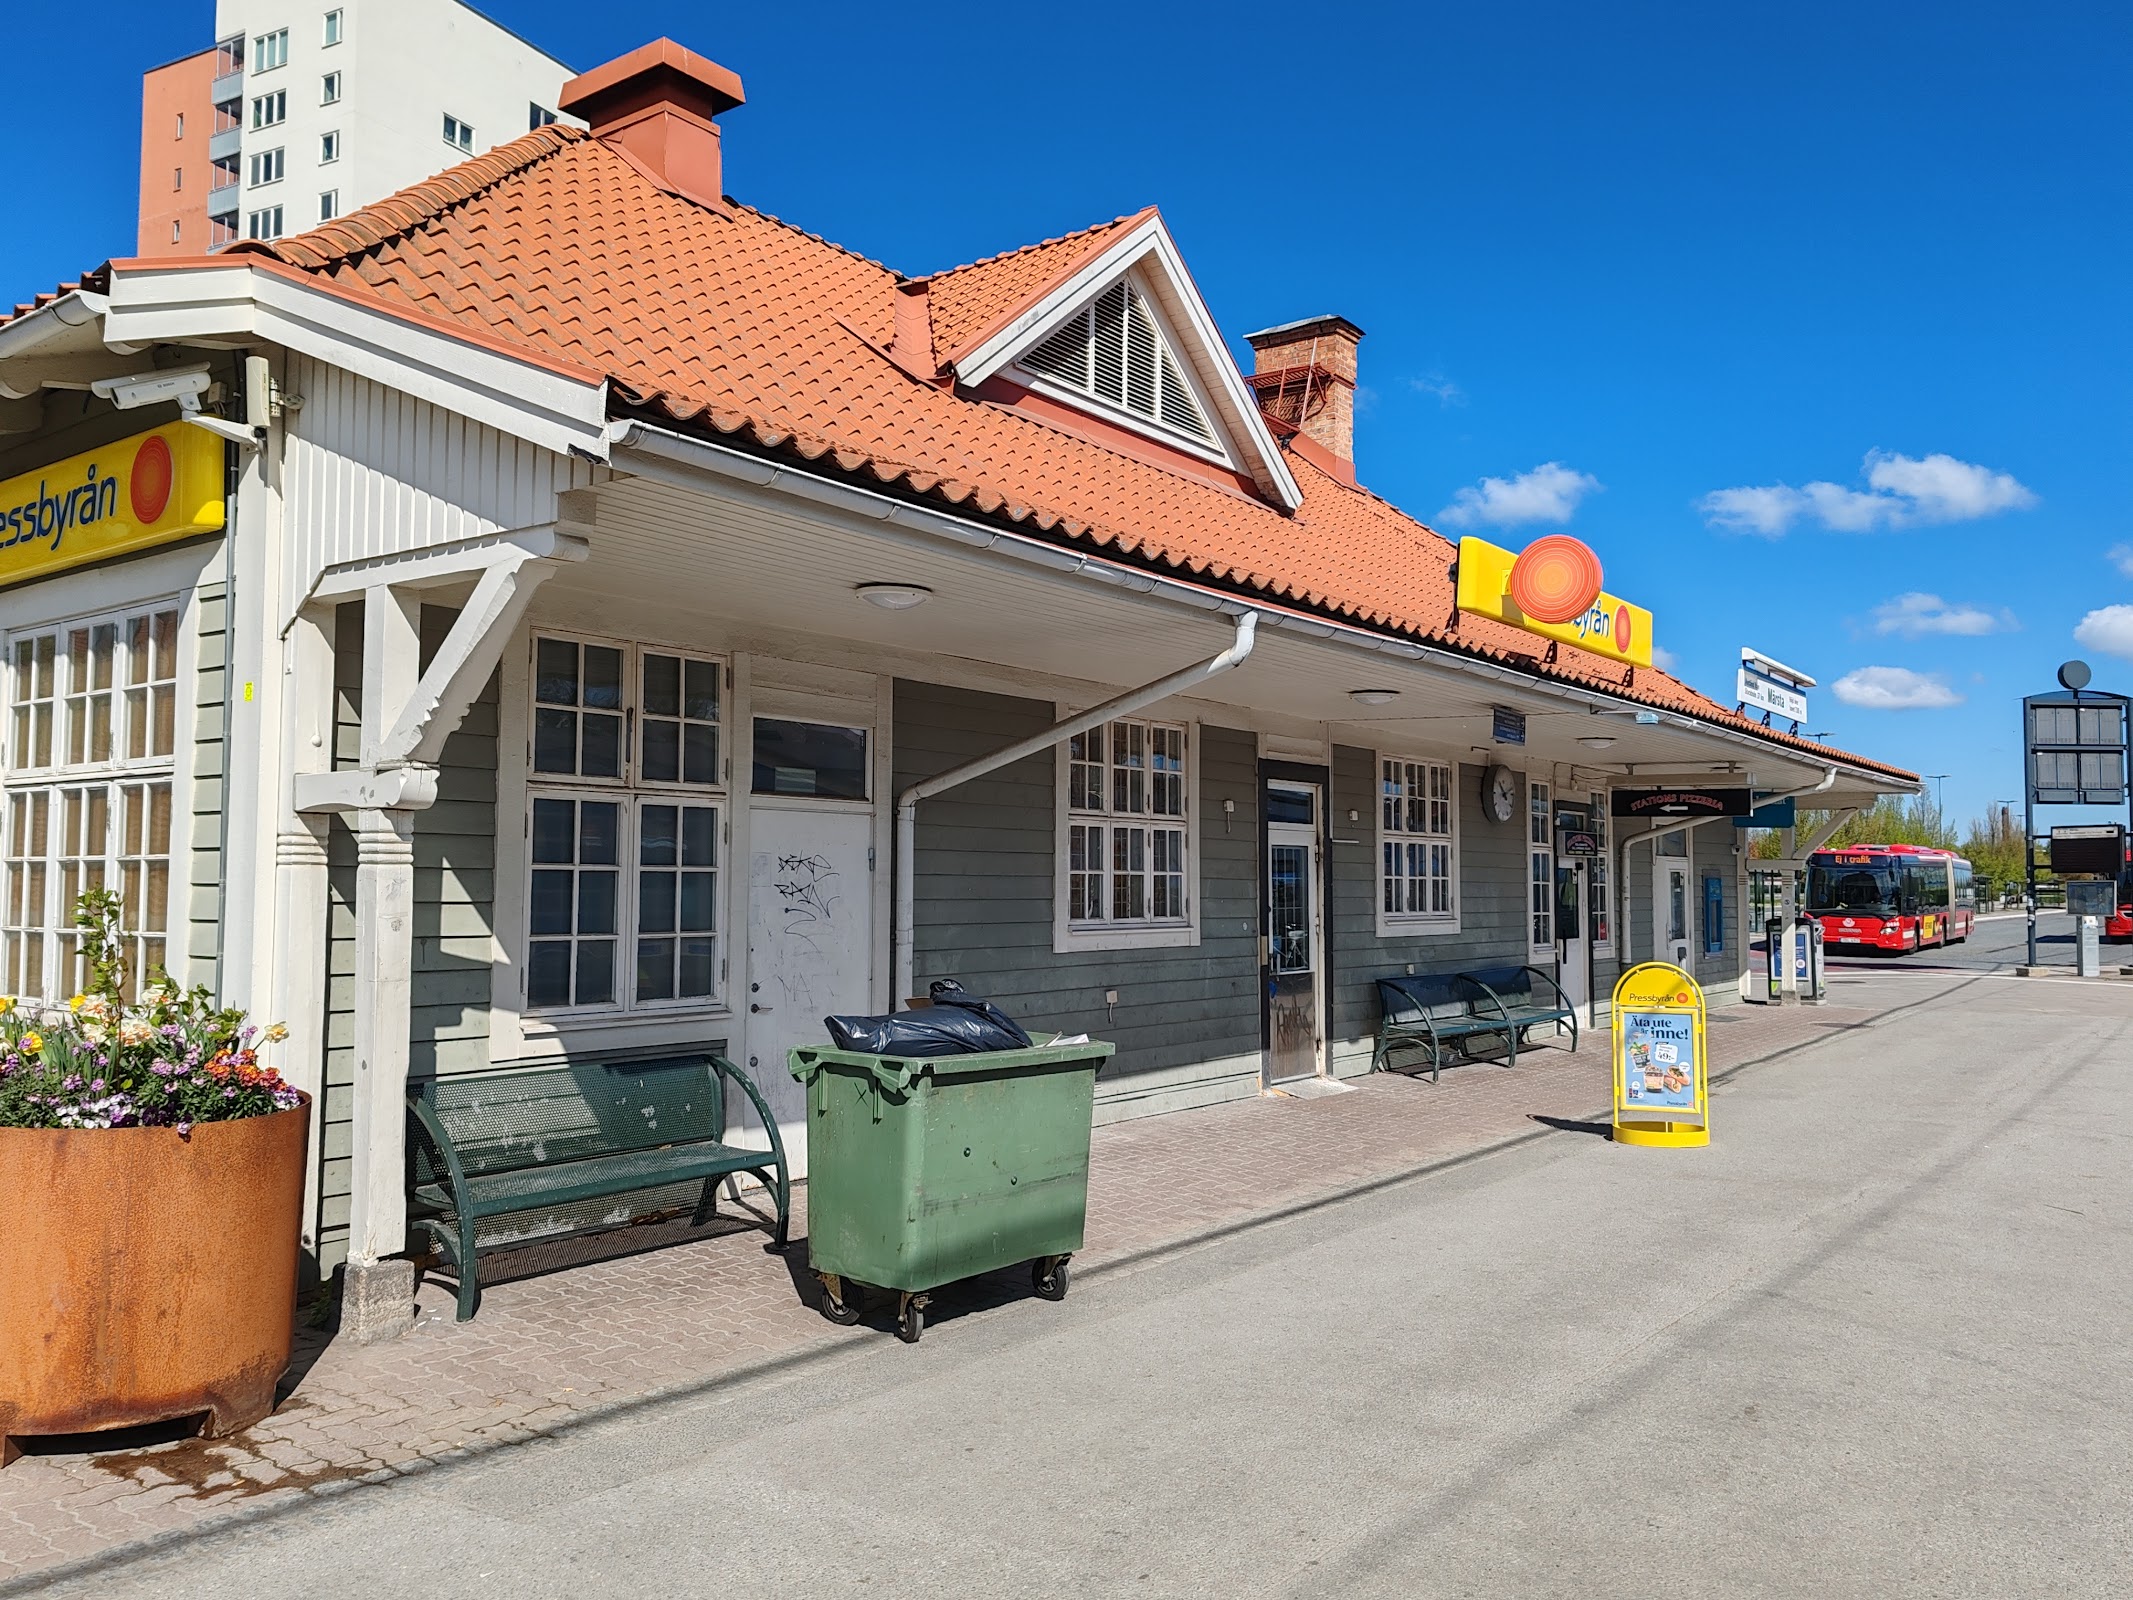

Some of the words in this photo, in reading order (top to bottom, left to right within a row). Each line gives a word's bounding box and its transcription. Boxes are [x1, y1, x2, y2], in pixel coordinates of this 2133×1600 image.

[1767, 687, 1785, 708] Märsta
[1630, 794, 1678, 811] STATIONS
[1679, 794, 1724, 811] PIZZERIA
[1835, 855, 1842, 865] Ej
[1849, 855, 1872, 864] trafik
[1628, 992, 1675, 1004] Pressbyrån
[1630, 1015, 1650, 1027] Äta
[1652, 1019, 1672, 1028] ute
[1650, 1026, 1689, 1040] inne!
